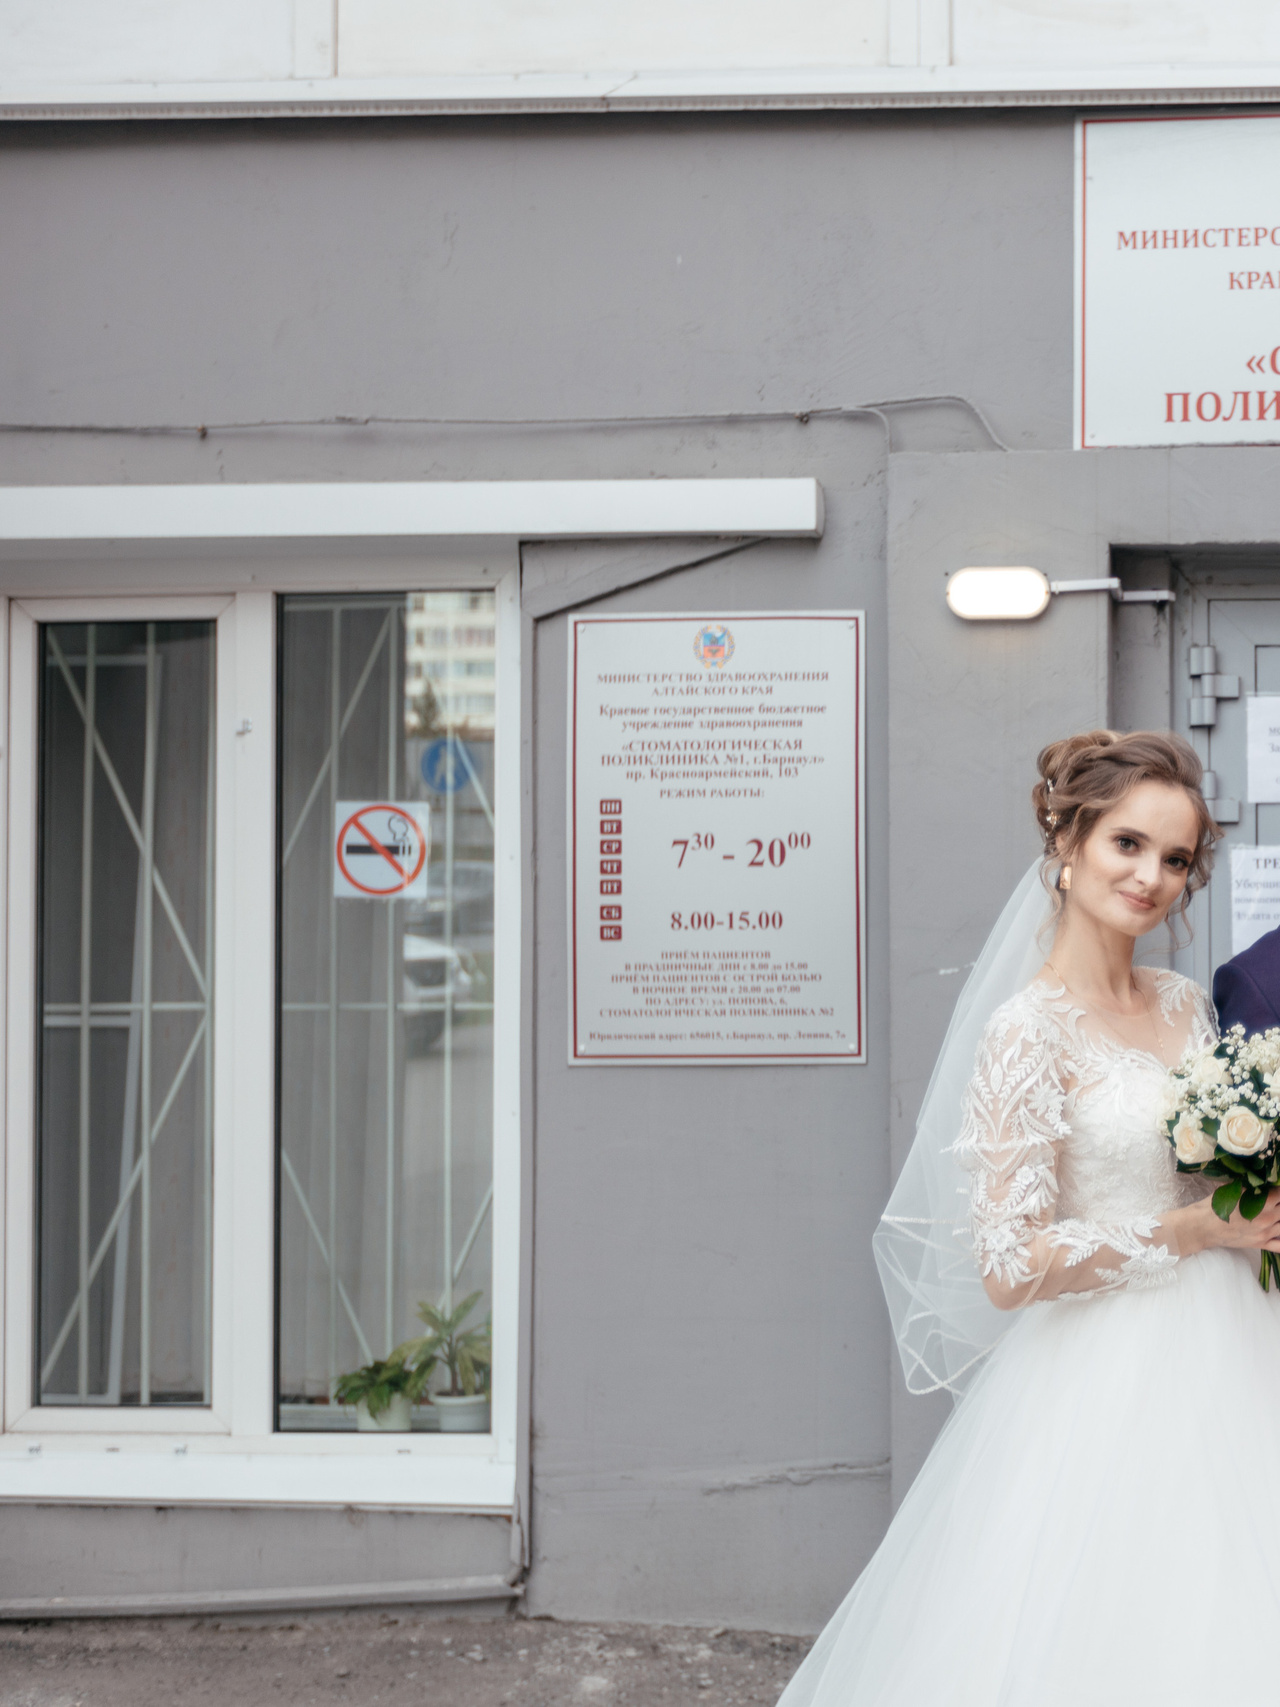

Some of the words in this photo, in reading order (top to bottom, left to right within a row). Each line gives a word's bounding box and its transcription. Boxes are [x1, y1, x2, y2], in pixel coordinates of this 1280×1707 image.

[596, 673, 703, 684] МИНИСТЕРСТВО
[706, 672, 829, 684] ЗДРАВООХРАНЕНИЯ
[651, 685, 738, 696] АЛТАЙСКОГО
[741, 686, 774, 696] КРАЯ
[600, 704, 650, 718] Краевое
[653, 705, 754, 718] государственное
[758, 703, 826, 716] бюджетное
[622, 719, 694, 732] учреждение
[698, 718, 803, 731] здравоохранения
[622, 739, 803, 752] «СТОМАТОЛОГИЧЕСКАЯ
[600, 754, 719, 767] ПОЛИКЛИНИКА
[723, 754, 750, 767] №1,
[626, 770, 645, 781] пр.
[650, 767, 774, 781] Красноармейский,
[778, 766, 799, 778] 103
[660, 788, 706, 798] РЕЖИМ
[710, 788, 765, 798] РАБОТЫ:
[601, 800, 620, 814] ПН
[603, 821, 619, 833] ВТ
[602, 841, 620, 853] СР
[602, 860, 620, 873] ЧТ
[602, 881, 620, 894] ПТ
[602, 907, 620, 920] СБ
[670, 910, 783, 931] 8.00-15.00
[602, 926, 620, 939] ВС
[661, 950, 700, 960] ПРИЁМ
[702, 950, 771, 961] ПАЦИЕНТОВ
[625, 962, 632, 971] В
[634, 962, 715, 972] ПРАЗДНИЧНЫЕ
[716, 962, 740, 972] ДНИ
[785, 962, 808, 970] 15.00
[611, 973, 650, 983] ПРИЁМ
[652, 974, 721, 984] ПАЦИЕНТОВ
[723, 974, 731, 983] С
[733, 972, 779, 982] ОСТРОЙ
[781, 974, 822, 982] БОЛЬЮ
[632, 986, 639, 994] В
[642, 986, 688, 994] НОЧНОЕ
[691, 986, 728, 994] ВРЕМЯ
[777, 985, 800, 994] 07.00
[646, 996, 662, 1006] ПО
[664, 996, 710, 1008] АДРЕСУ:
[728, 996, 778, 1007] ПОПОВА,
[600, 1008, 727, 1018] СТОМАТОЛОГИЧЕСКАЯ
[729, 1008, 816, 1018] ПОЛИКЛИНИКА
[589, 1031, 656, 1042] Юридический
[659, 1032, 688, 1042] адрес:
